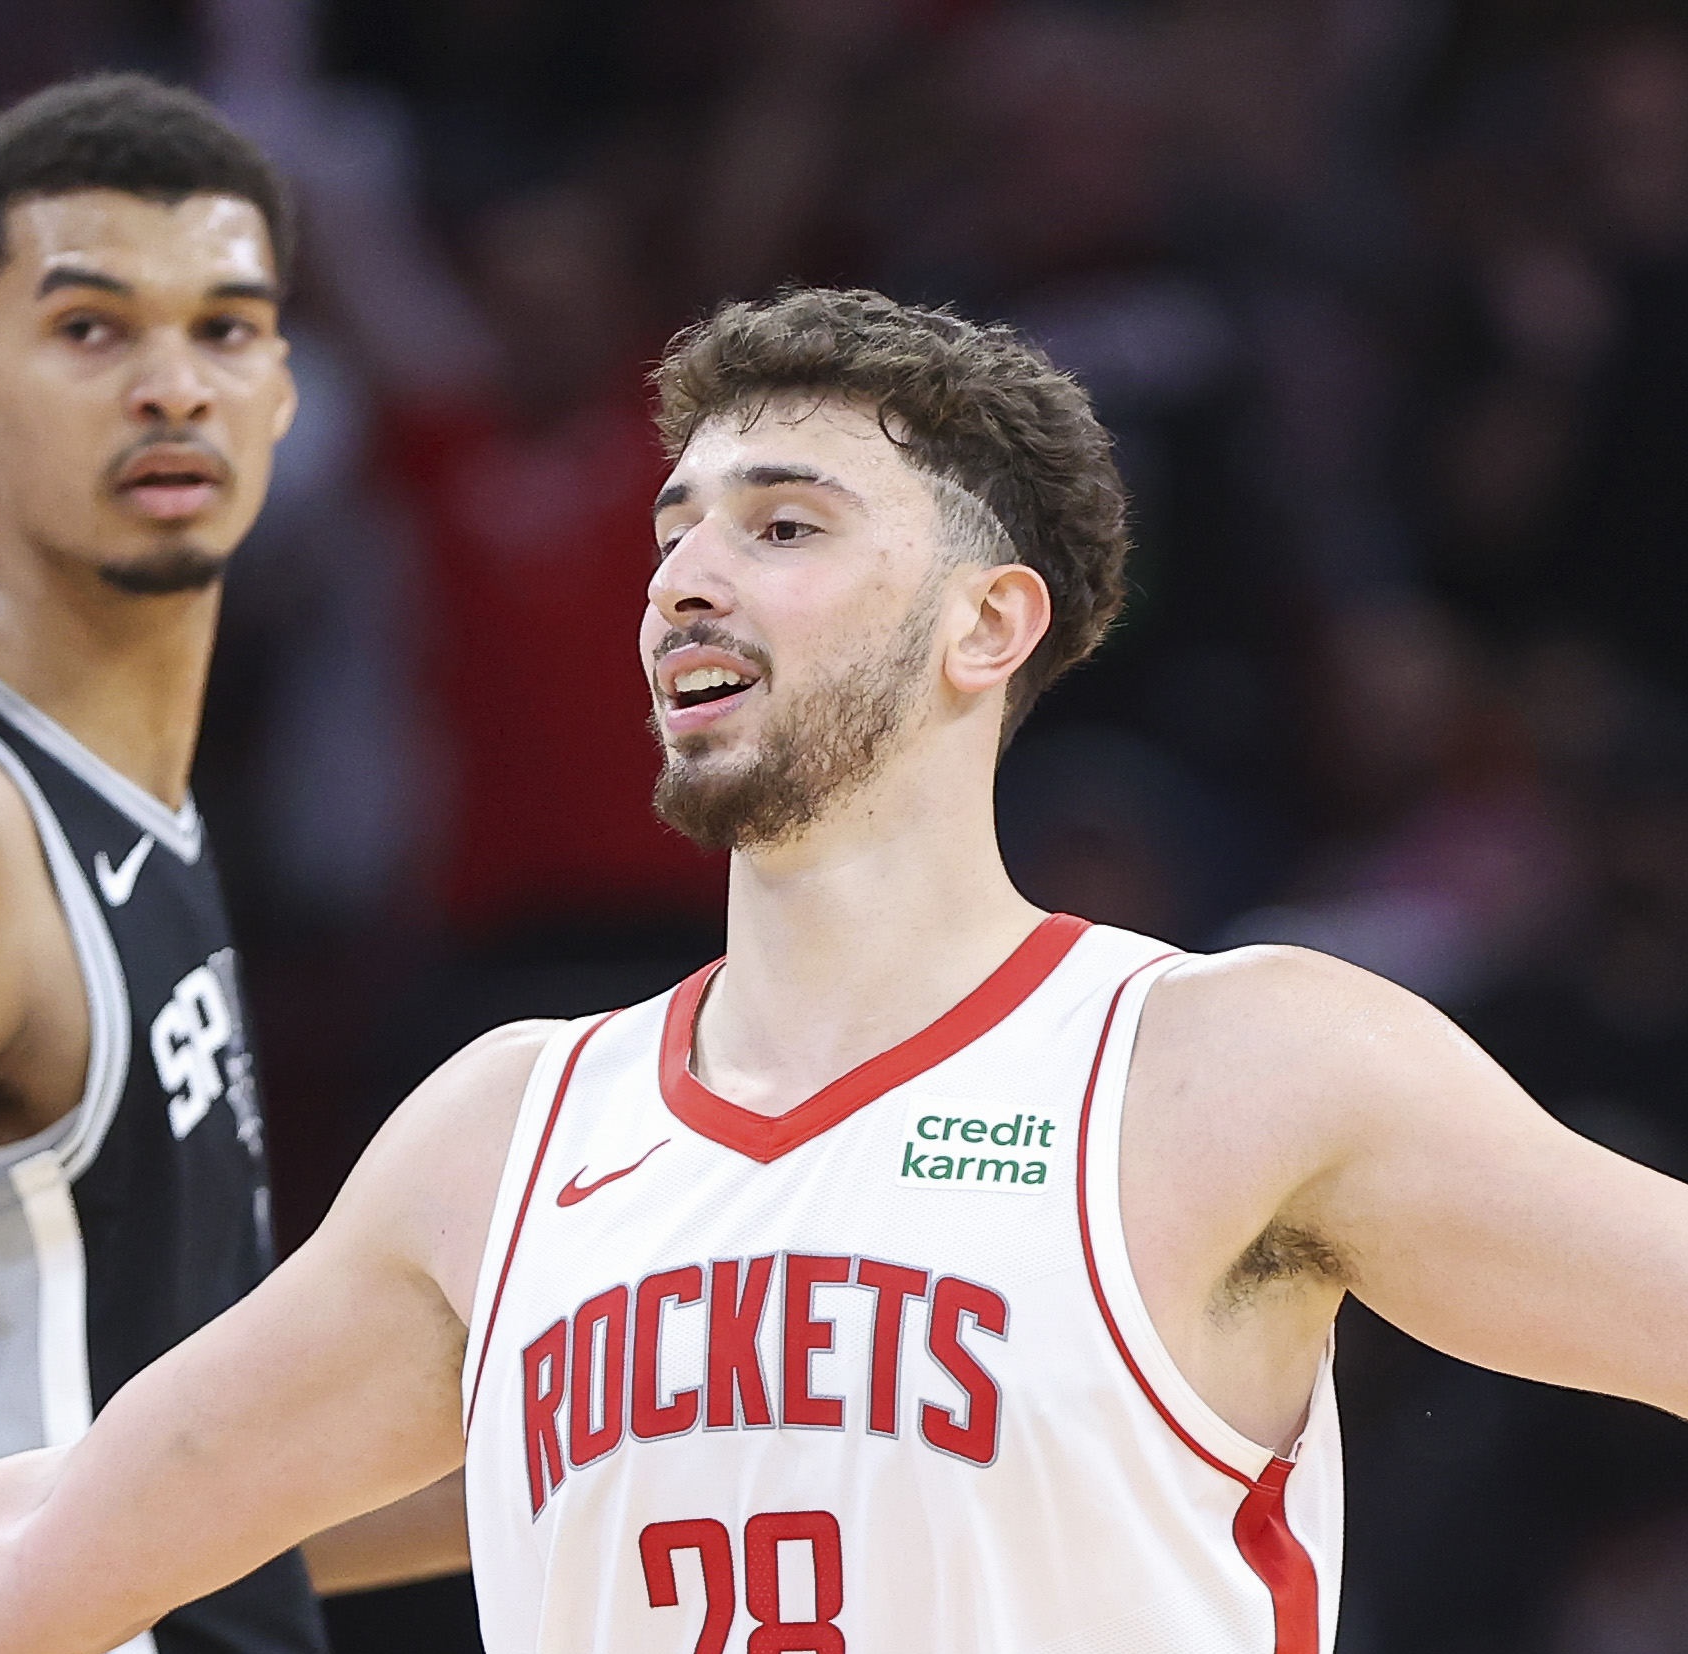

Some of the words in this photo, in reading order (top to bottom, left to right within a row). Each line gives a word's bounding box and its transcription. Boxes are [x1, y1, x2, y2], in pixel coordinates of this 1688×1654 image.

[150, 952, 243, 1140] SP
[901, 1142, 1048, 1185] karma
[916, 1114, 1056, 1148] credit
[521, 1250, 1011, 1524] ROCKETS
